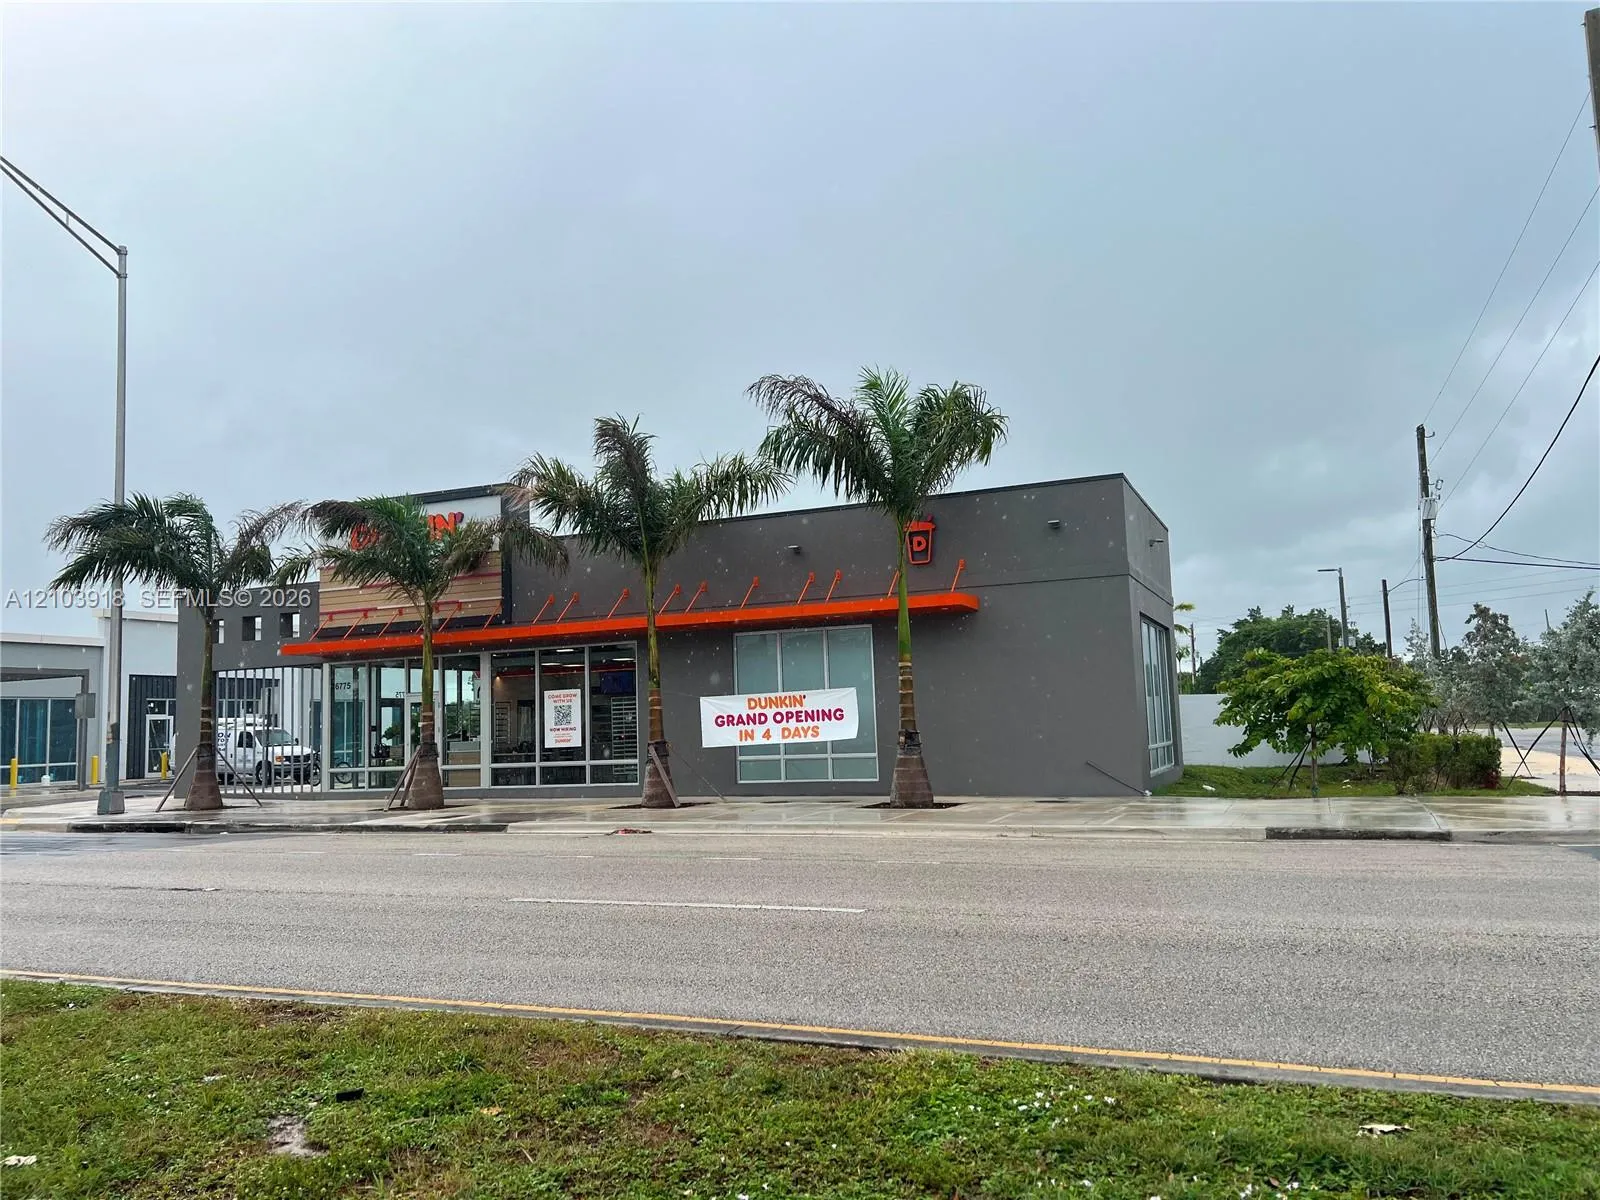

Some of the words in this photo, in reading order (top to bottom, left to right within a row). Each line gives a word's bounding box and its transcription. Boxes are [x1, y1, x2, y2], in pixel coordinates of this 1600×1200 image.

[912, 535, 927, 551] D
[747, 694, 807, 711] DUNKIN'
[714, 712, 769, 728] GRAND
[772, 707, 845, 725] OPENING
[739, 729, 755, 742] IN
[762, 728, 772, 741] 4
[781, 725, 821, 740] DAYS
